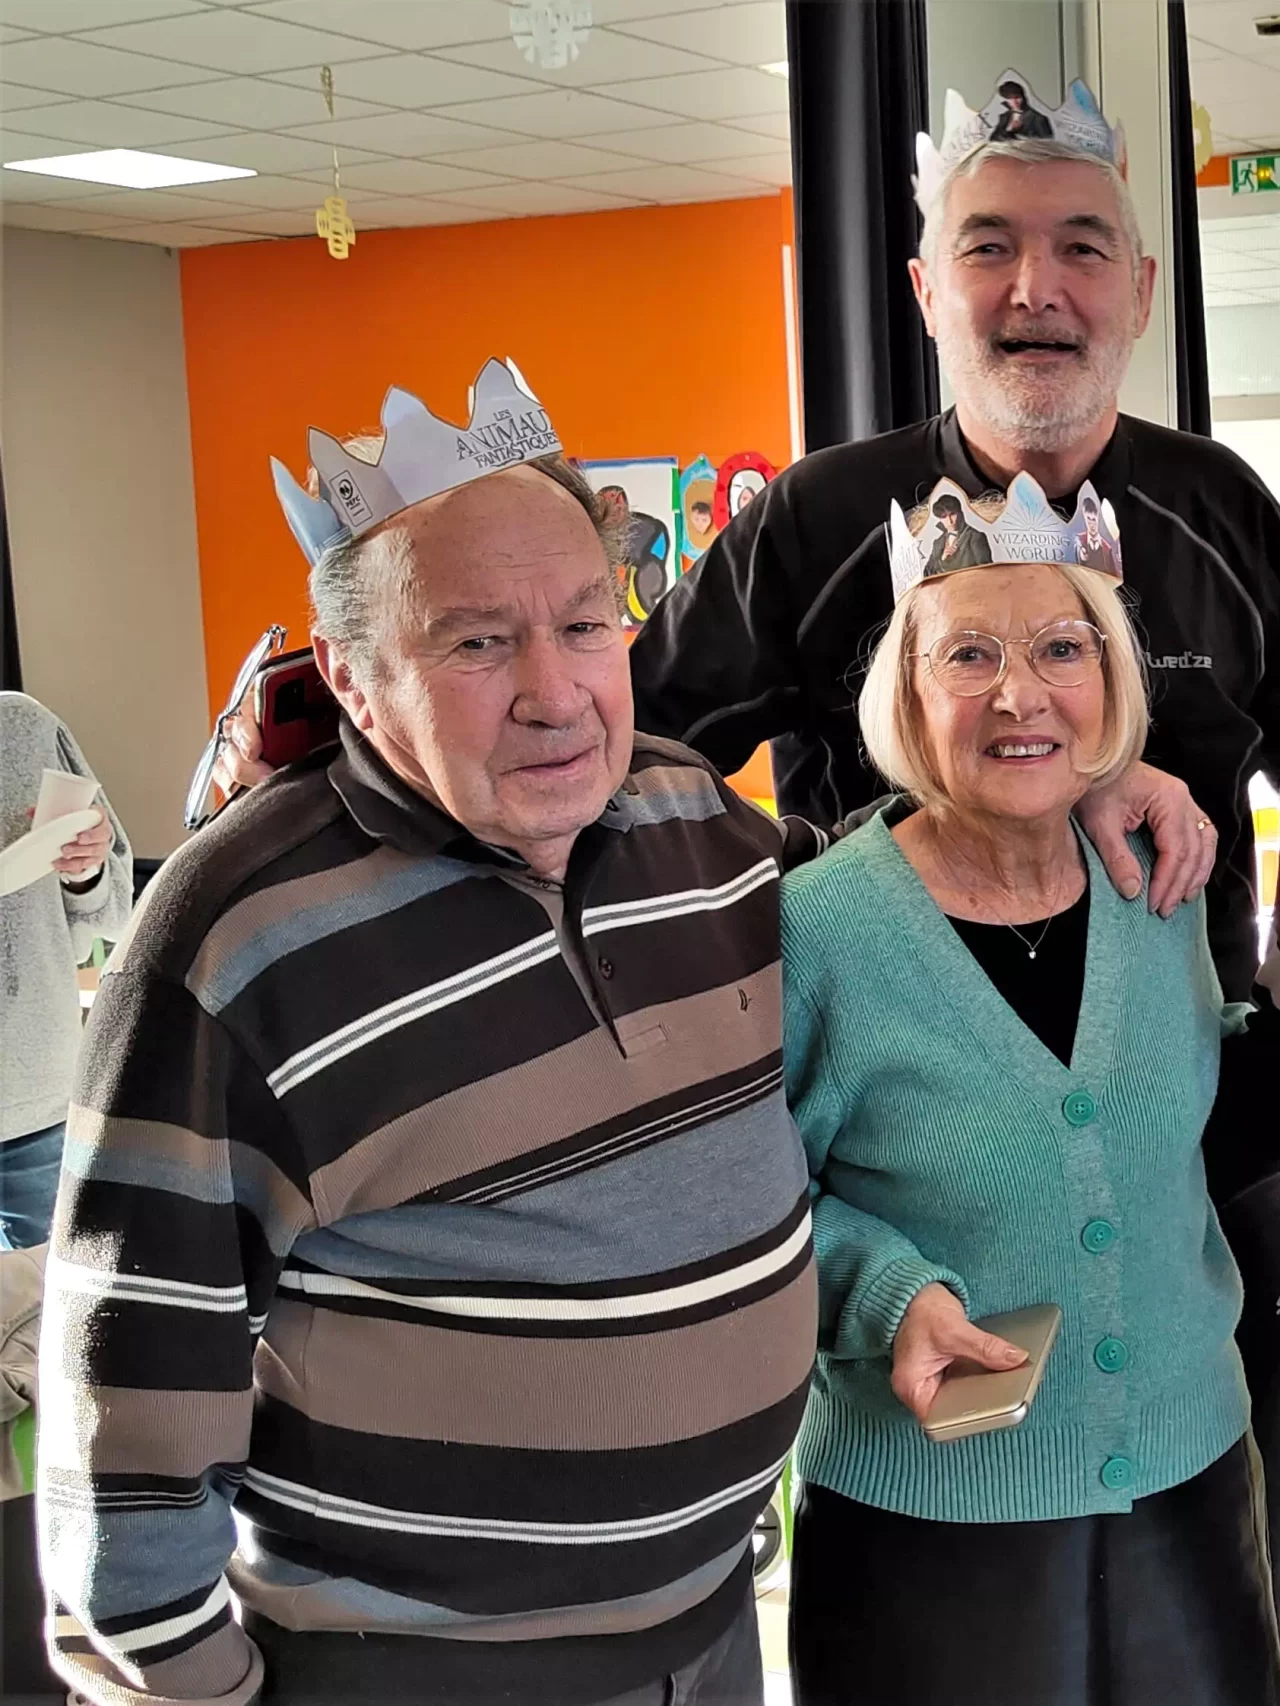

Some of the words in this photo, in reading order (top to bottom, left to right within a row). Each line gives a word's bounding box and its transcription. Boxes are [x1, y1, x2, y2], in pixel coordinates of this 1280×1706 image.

[493, 409, 512, 421] LES
[456, 409, 553, 460] ANIMAU
[993, 533, 1073, 547] WIZARDING
[1005, 546, 1065, 561] WORLD
